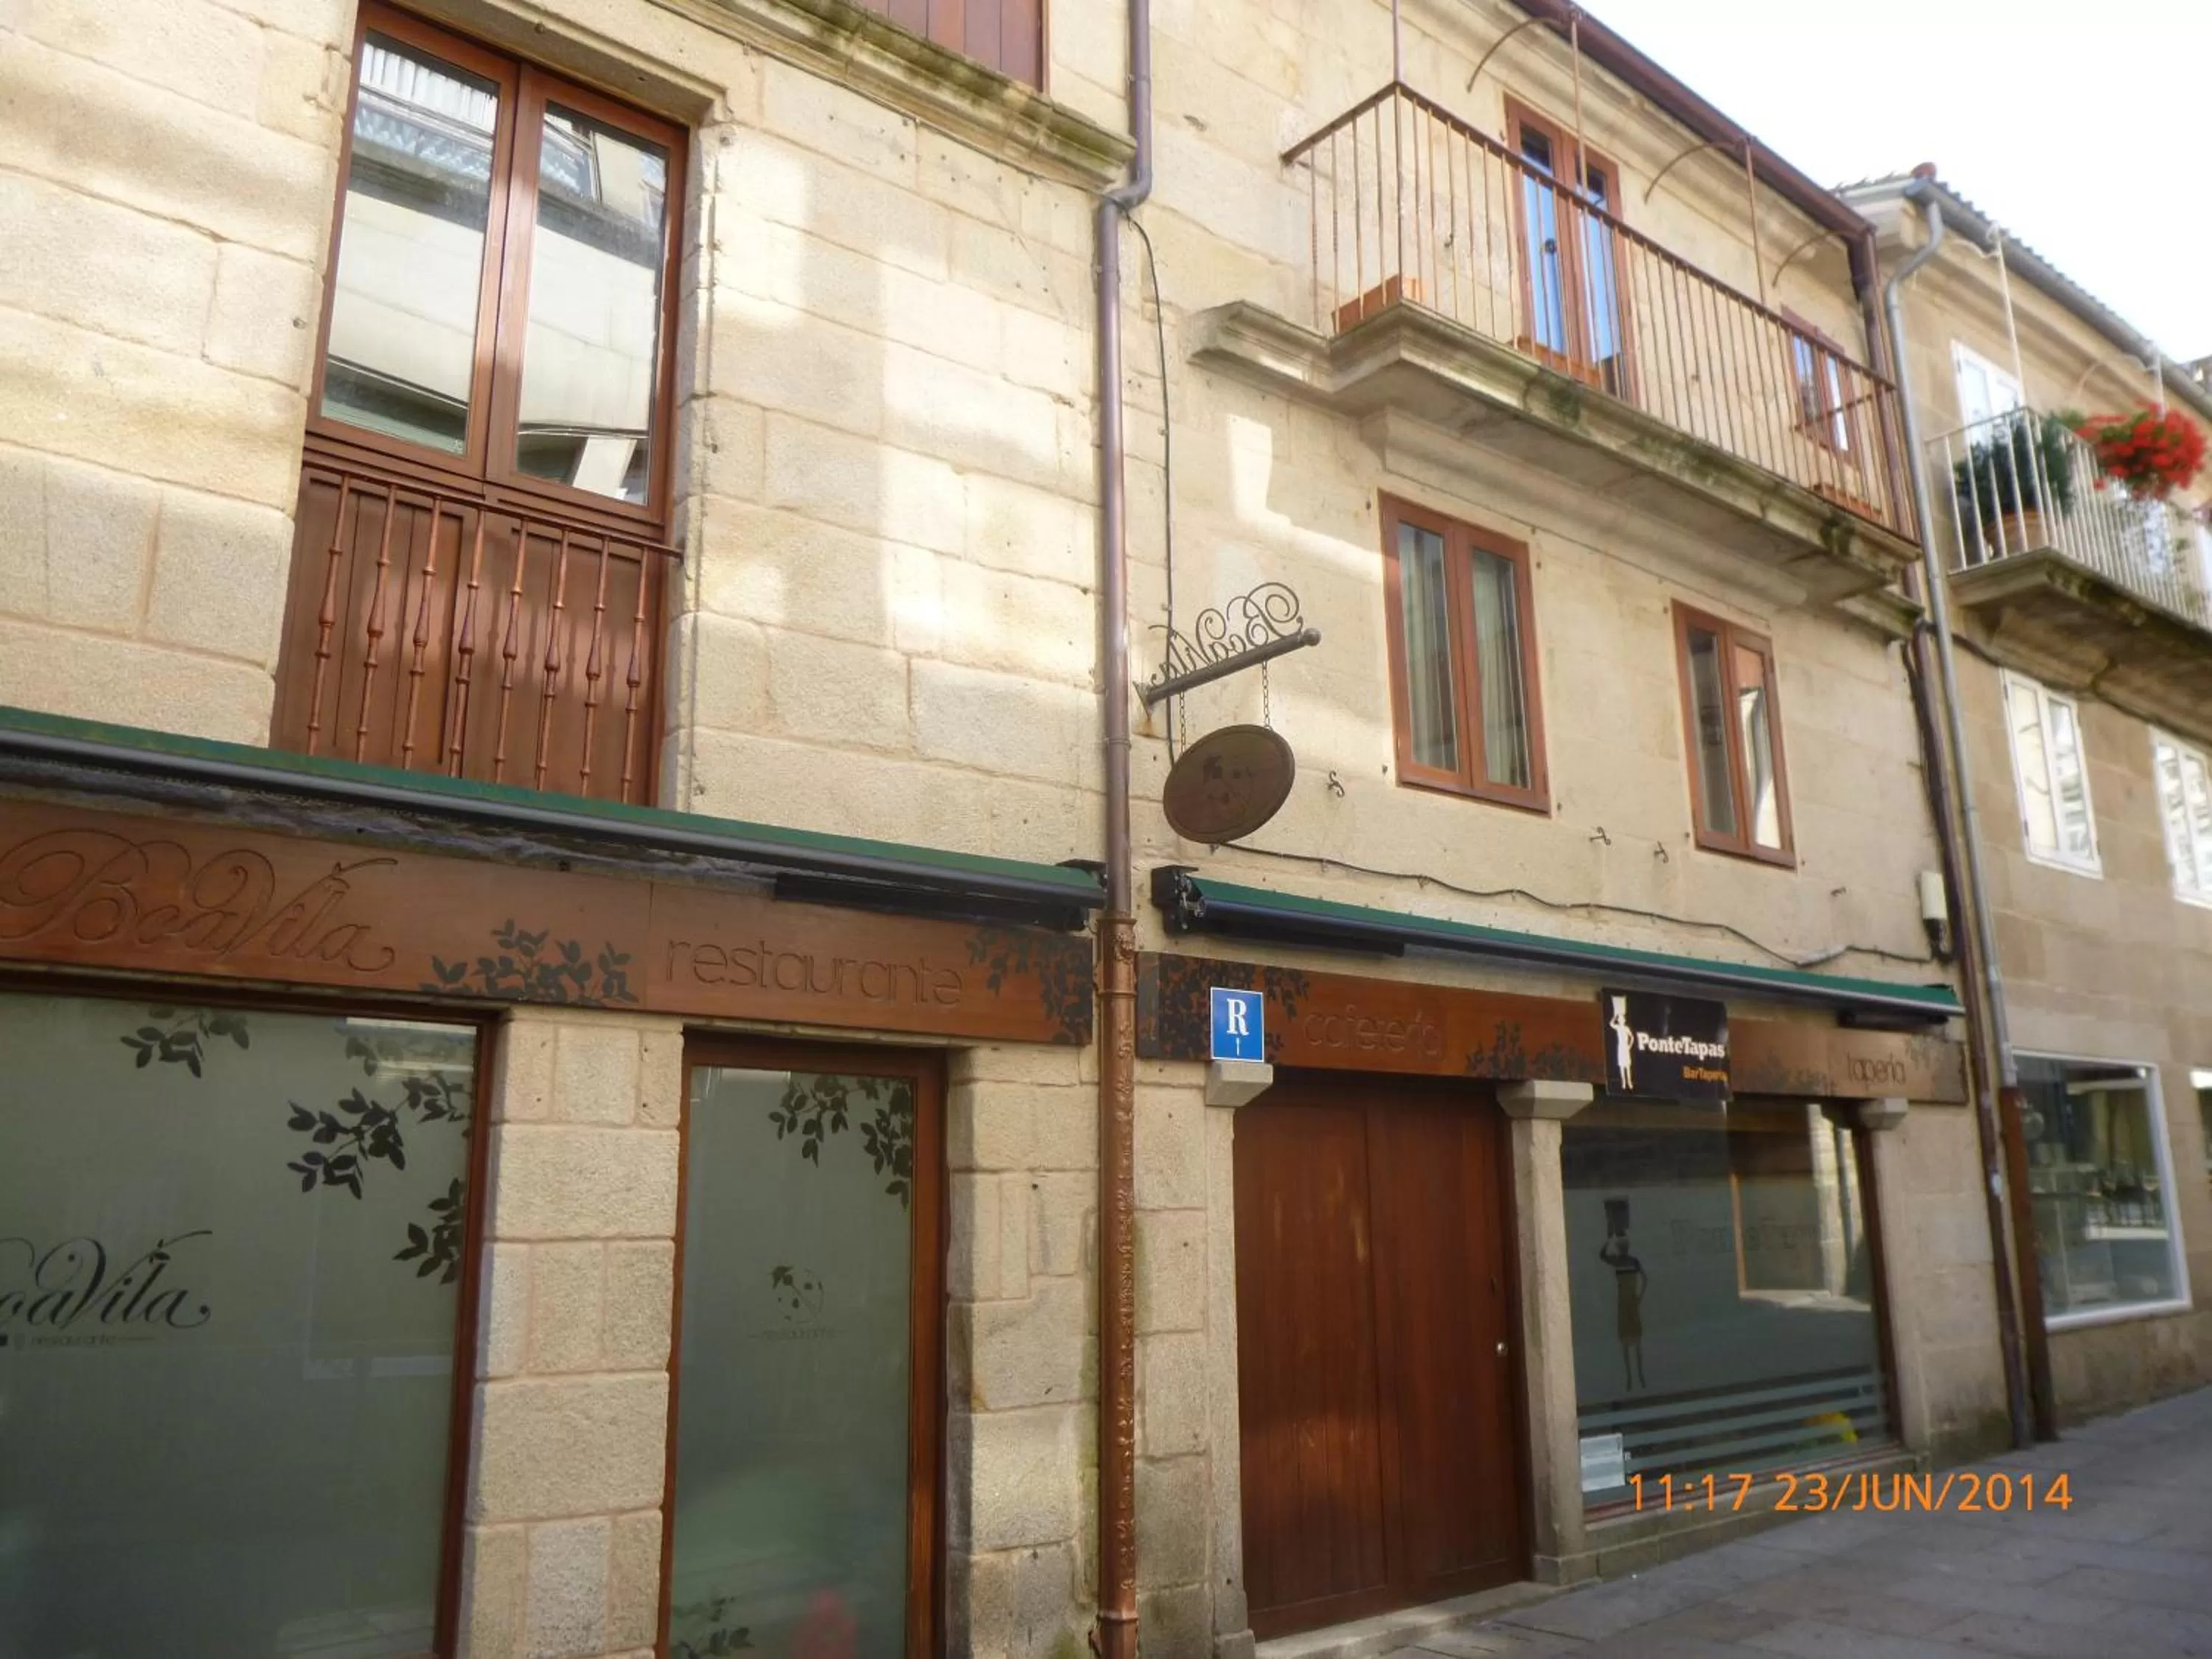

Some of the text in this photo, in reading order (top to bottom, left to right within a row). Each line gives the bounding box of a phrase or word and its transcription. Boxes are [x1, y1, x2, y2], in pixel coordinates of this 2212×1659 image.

[665, 939, 961, 1006] restaurante
[1225, 998, 1250, 1036] R
[1636, 1032, 1725, 1060] PonteTapas
